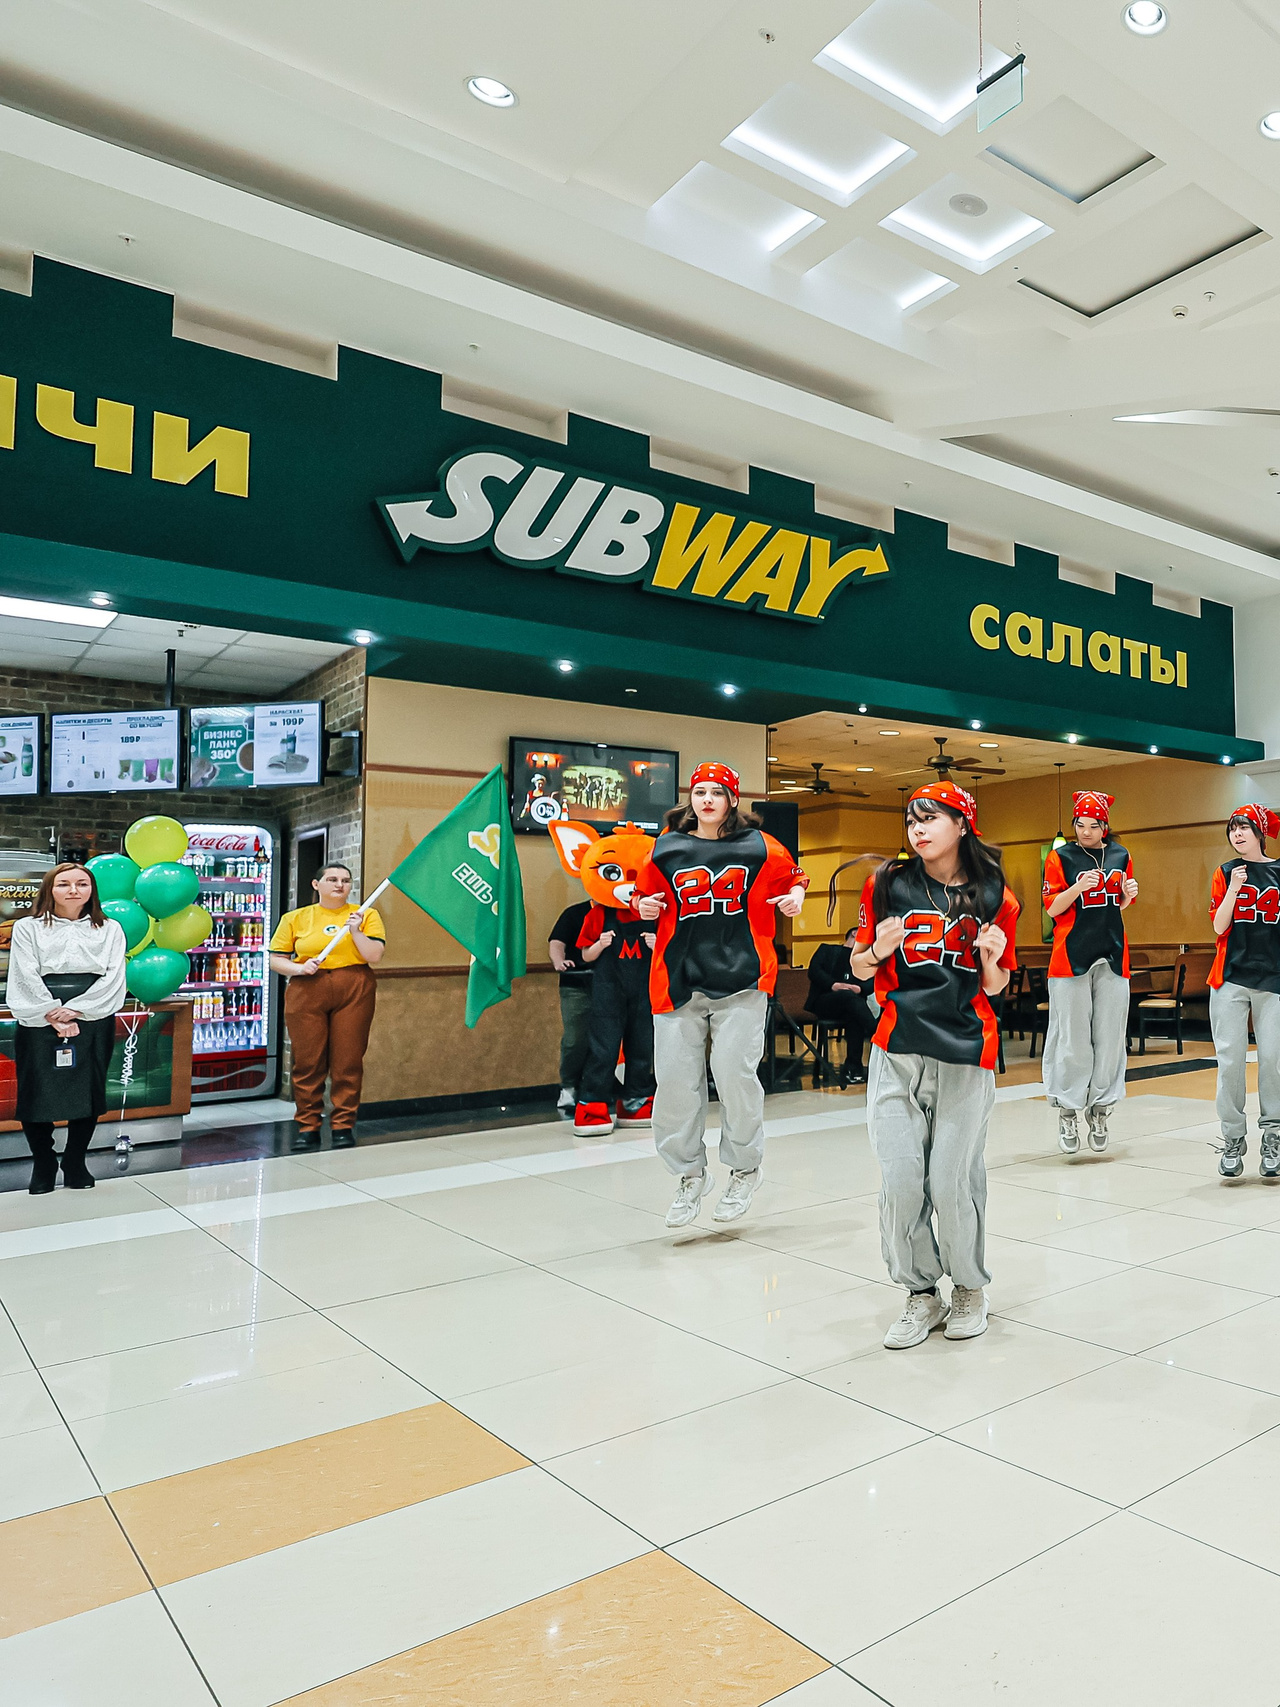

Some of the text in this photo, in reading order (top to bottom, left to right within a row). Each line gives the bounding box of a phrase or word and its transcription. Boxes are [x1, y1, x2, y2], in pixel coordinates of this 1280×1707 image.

[0, 374, 250, 498] чи
[385, 452, 890, 619] SUBWAY
[969, 603, 1188, 688] салаты
[204, 730, 242, 740] БИЗНЕС
[209, 740, 237, 749] ЛАНЧ
[10, 901, 33, 909] 129
[672, 865, 750, 921] 24
[1076, 868, 1122, 909] 24
[1233, 883, 1280, 924] 24
[900, 909, 983, 973] 24
